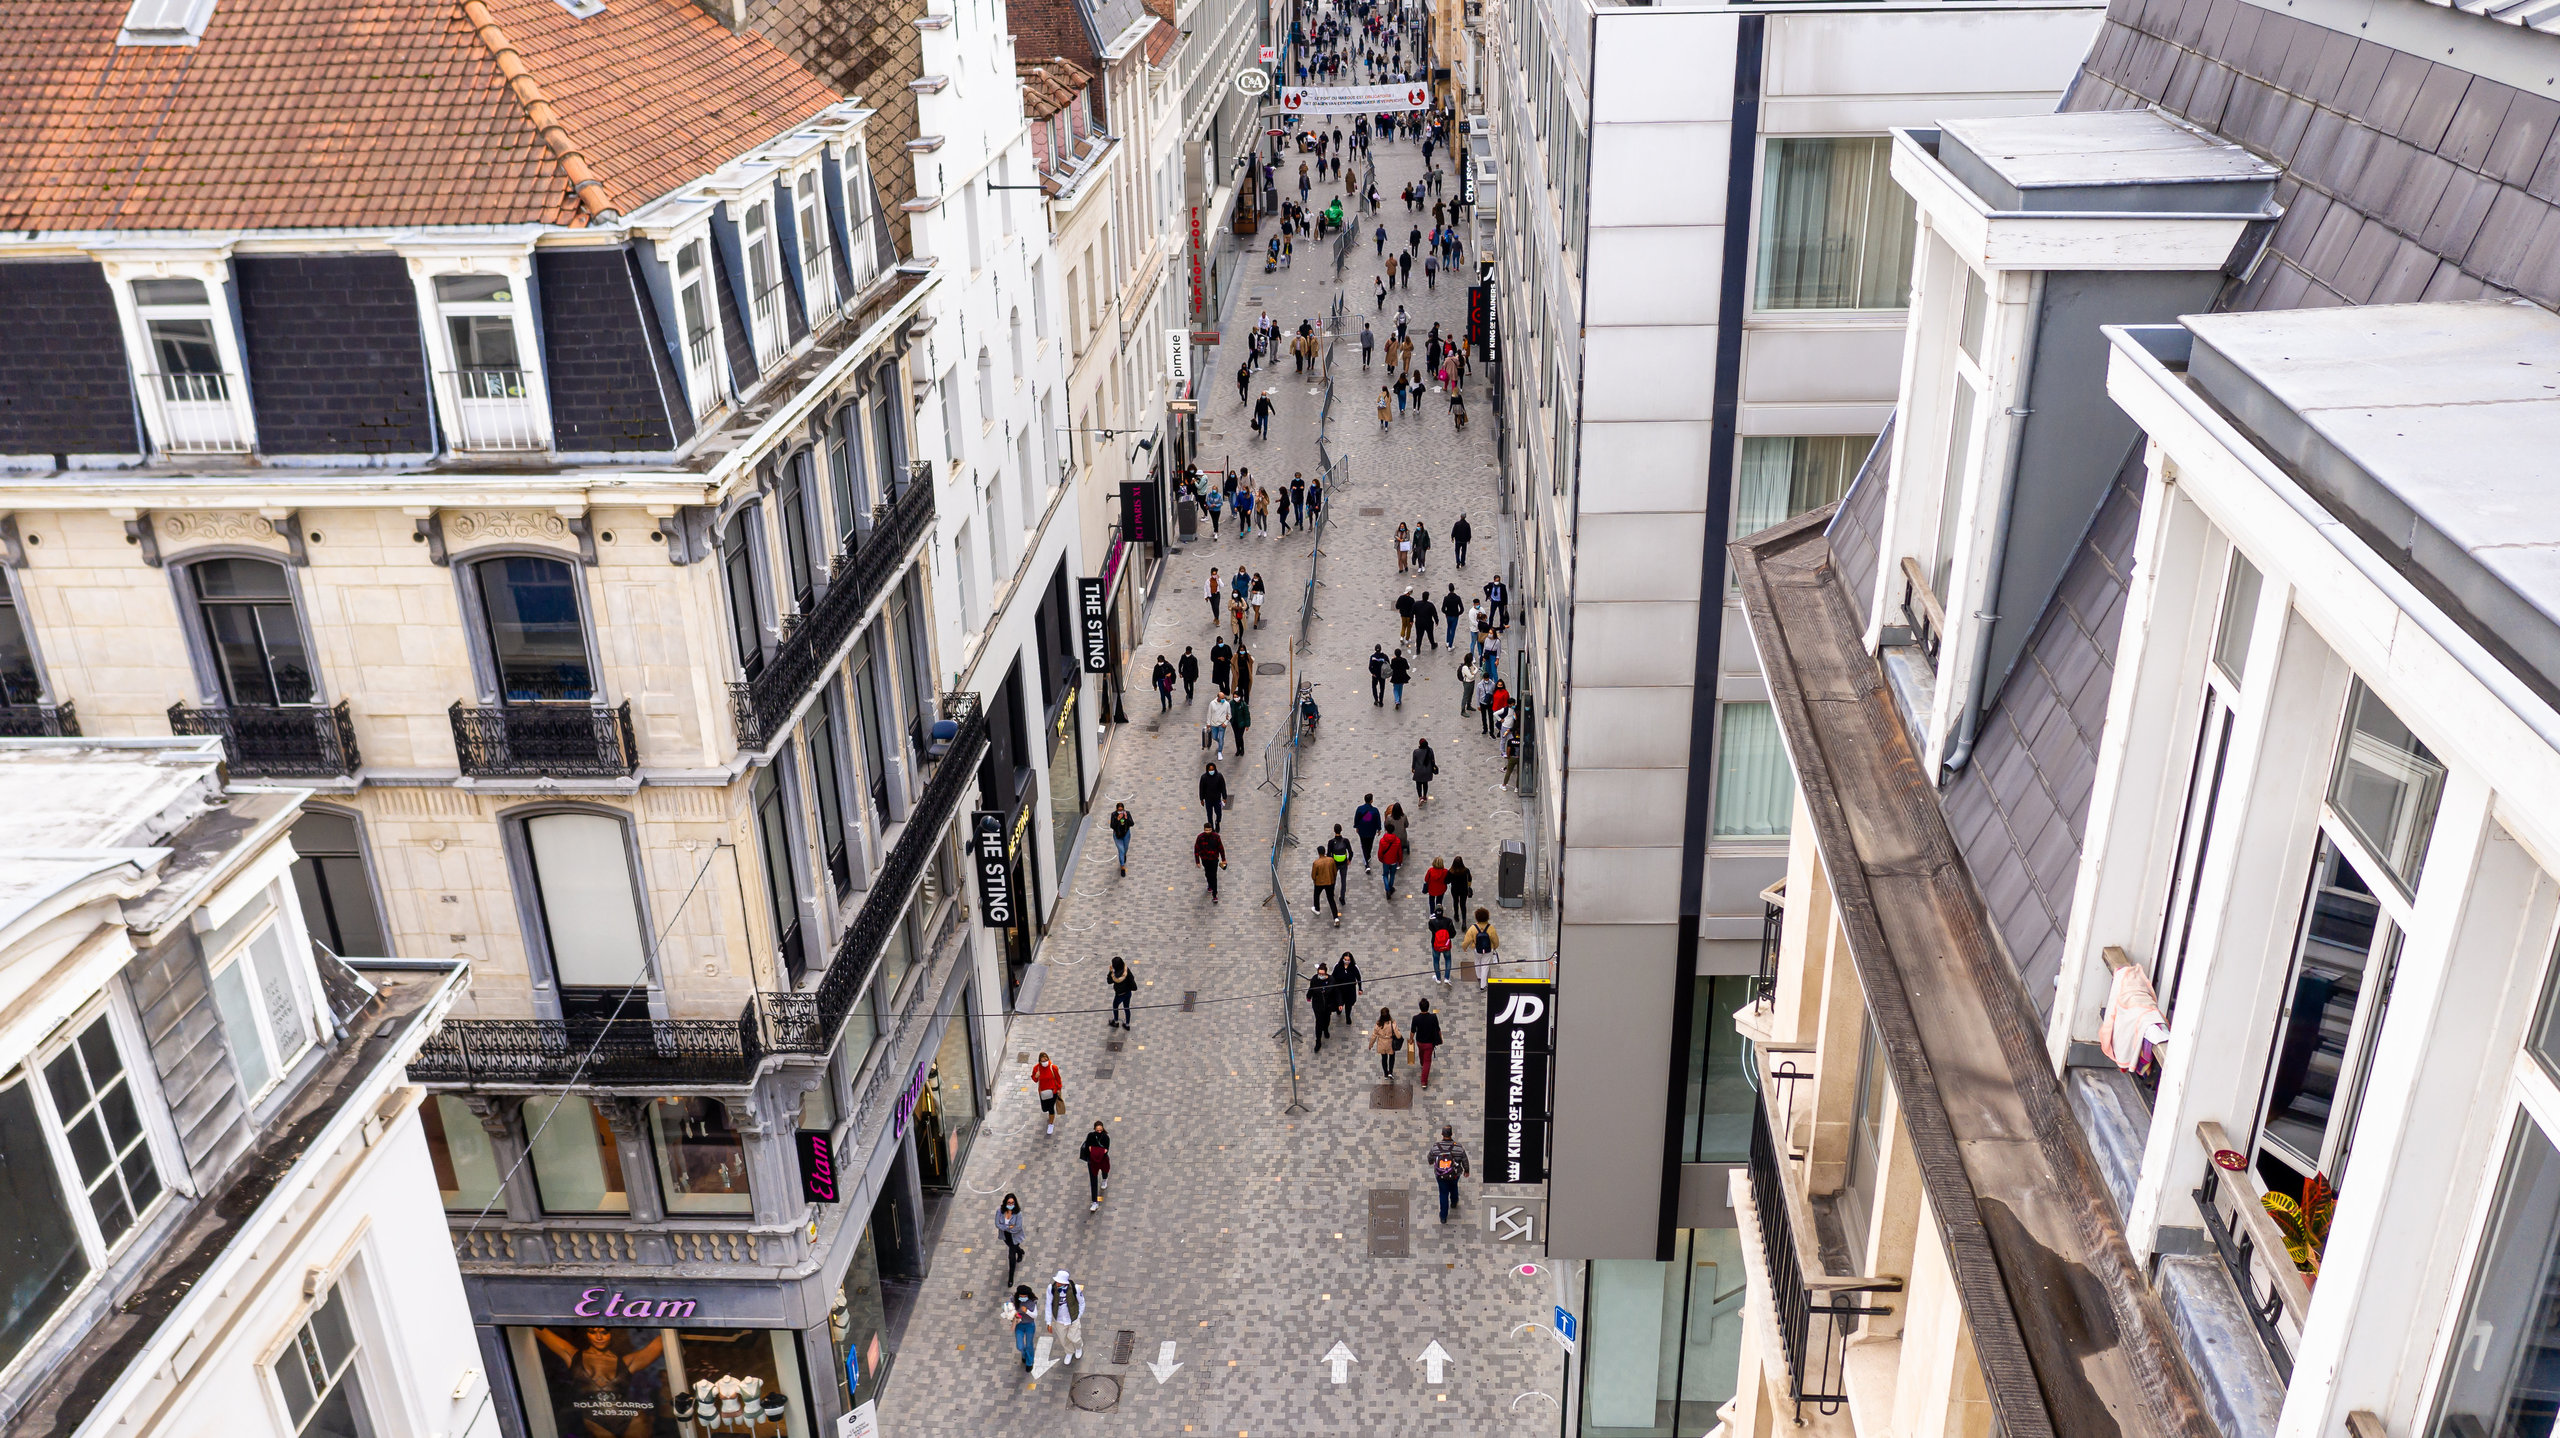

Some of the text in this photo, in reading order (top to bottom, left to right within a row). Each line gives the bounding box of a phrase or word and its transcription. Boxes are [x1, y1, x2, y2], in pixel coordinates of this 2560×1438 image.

[1240, 75, 1263, 89] C&A
[1489, 283, 1497, 320] TRAINERS
[1132, 486, 1143, 539] ICI PARIS XL
[1085, 583, 1105, 669] THE STING
[1015, 804, 1029, 844] STING
[982, 829, 1010, 922] HE STING
[1493, 993, 1544, 1024] JD
[1508, 1029, 1525, 1158] KING OF TRAINERS
[810, 1136, 834, 1200] Etam
[574, 1287, 697, 1318] Etam
[572, 1401, 655, 1409] ROLAND-GARROS
[591, 1409, 639, 1417] 24.09.2019
